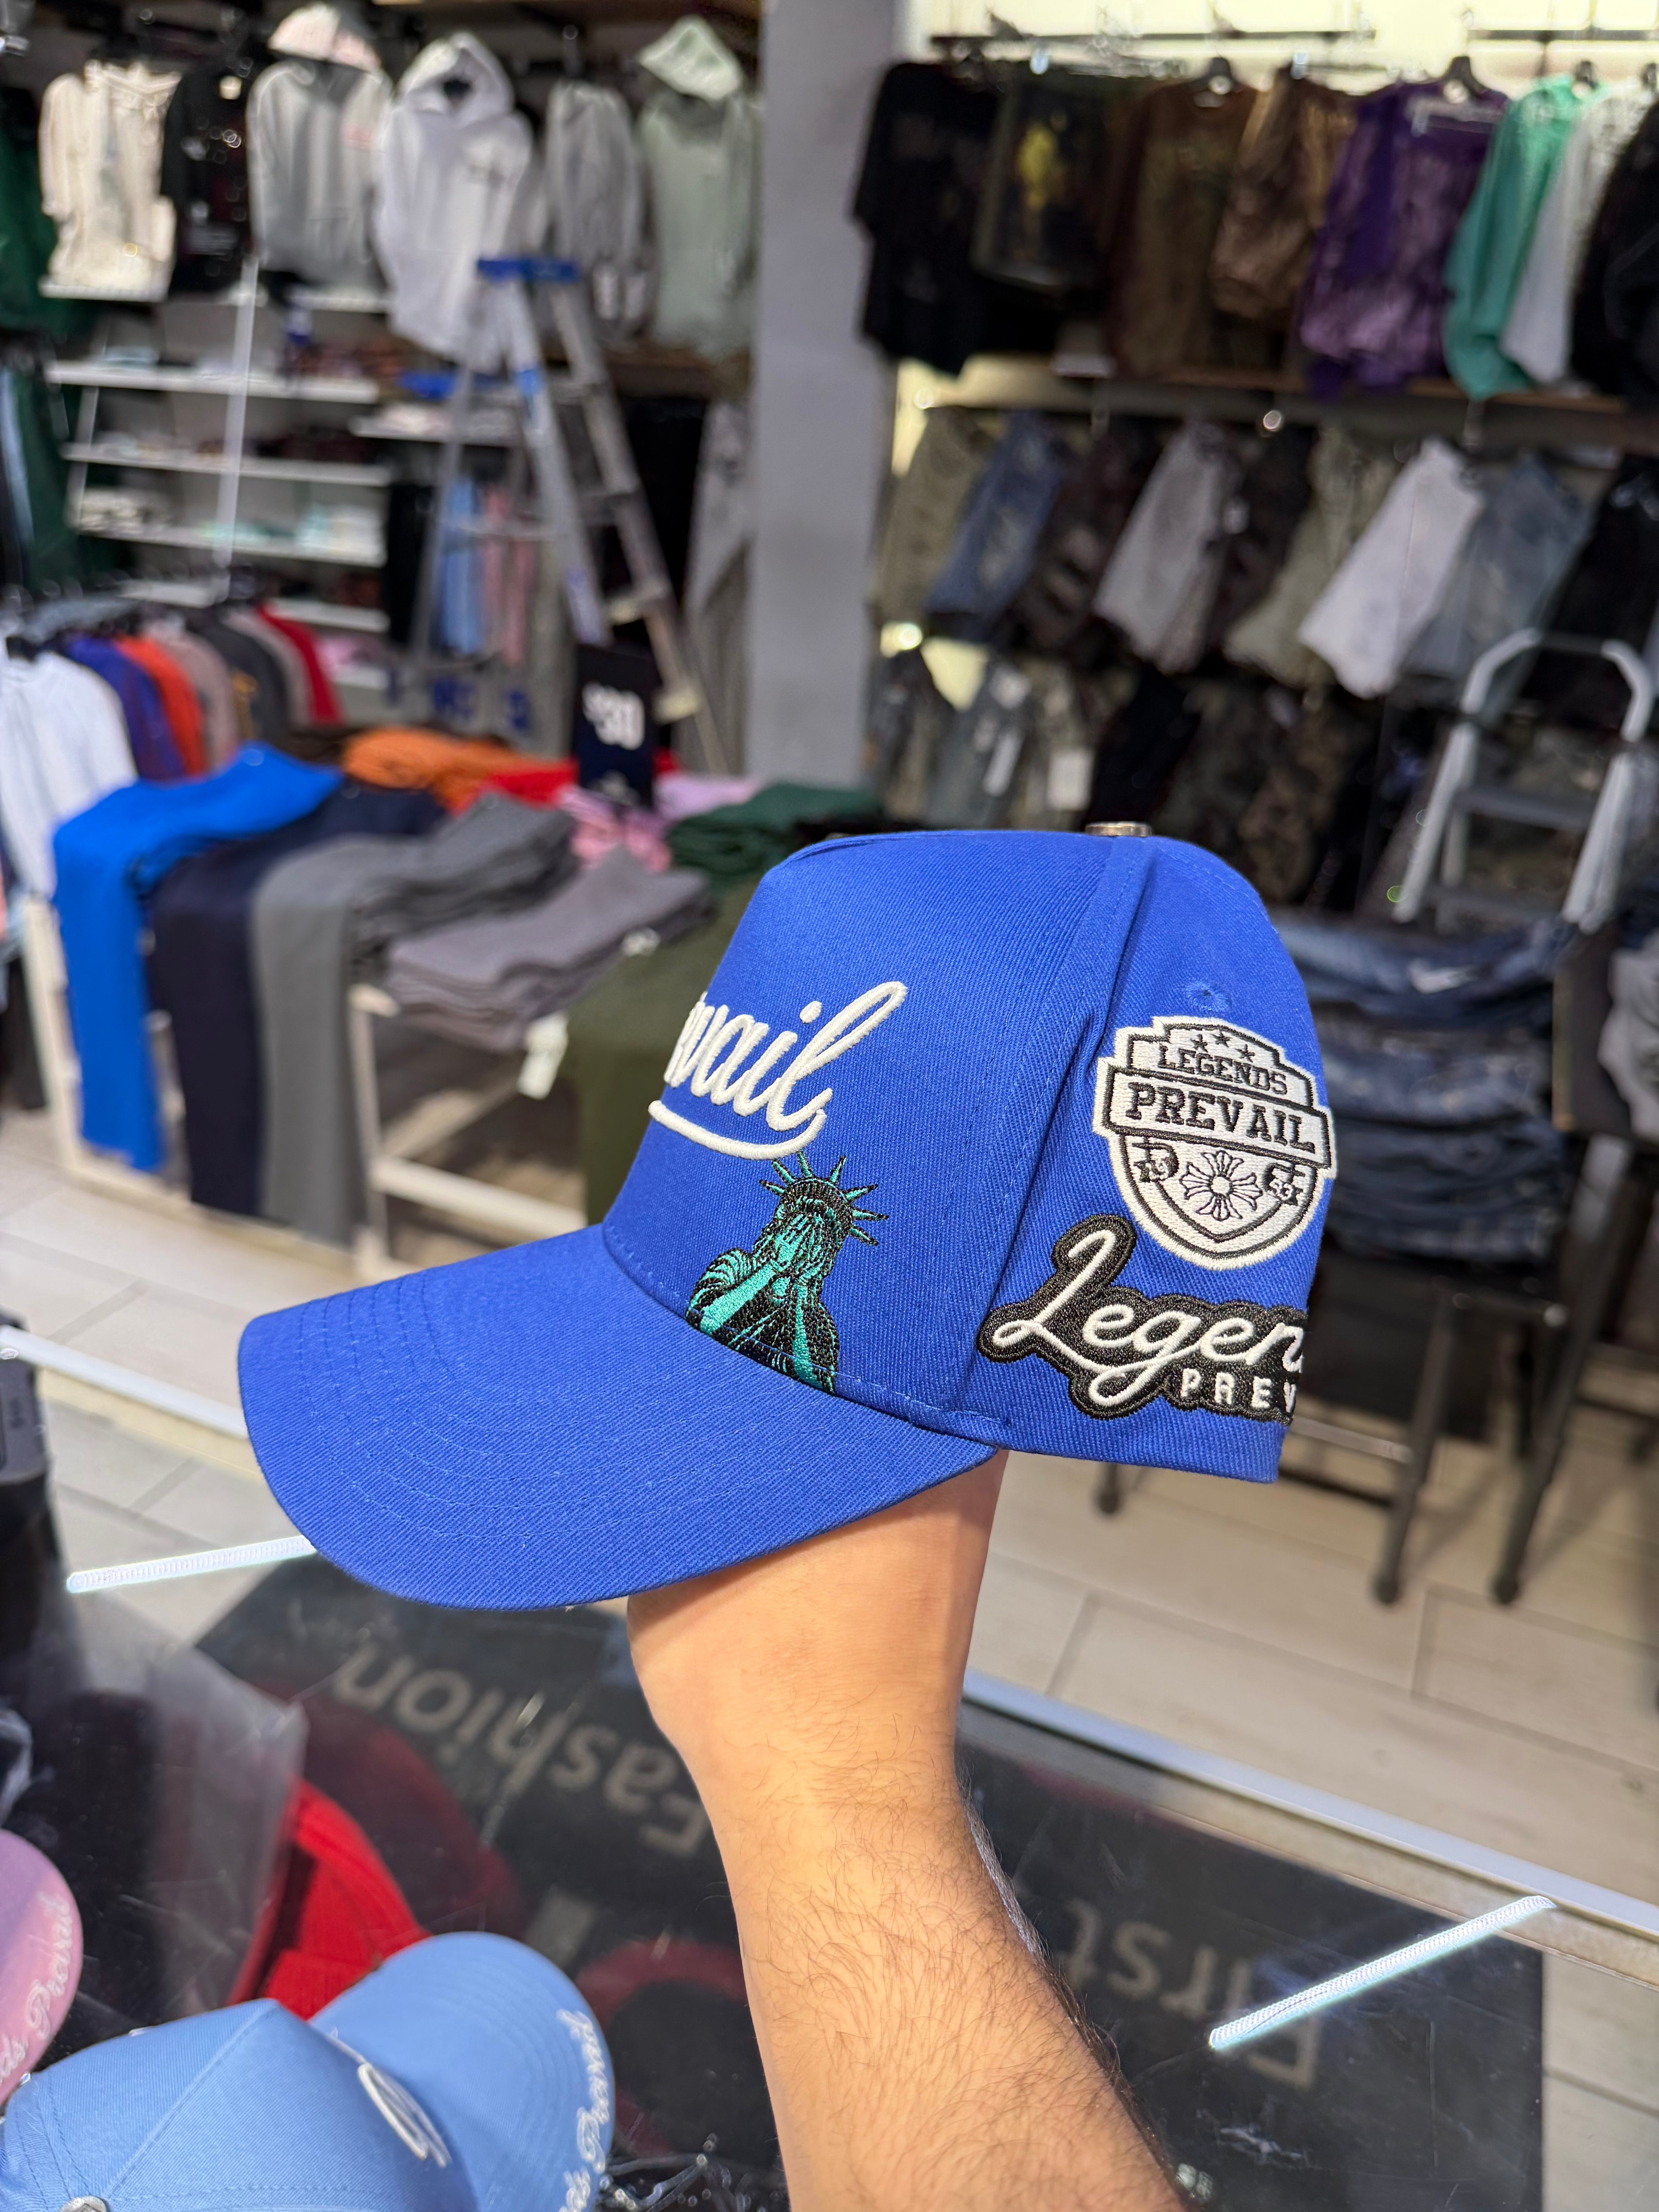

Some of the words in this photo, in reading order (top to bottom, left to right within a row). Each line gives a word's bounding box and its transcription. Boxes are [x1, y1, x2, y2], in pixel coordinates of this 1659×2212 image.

[664, 981, 907, 1131] vail
[1158, 1043, 1287, 1095] LEGENDS
[1126, 1082, 1315, 1154] PREVAIL
[992, 1229, 1303, 1407] Legen
[1180, 1367, 1296, 1413] PREV
[334, 1646, 709, 1854] Fashion
